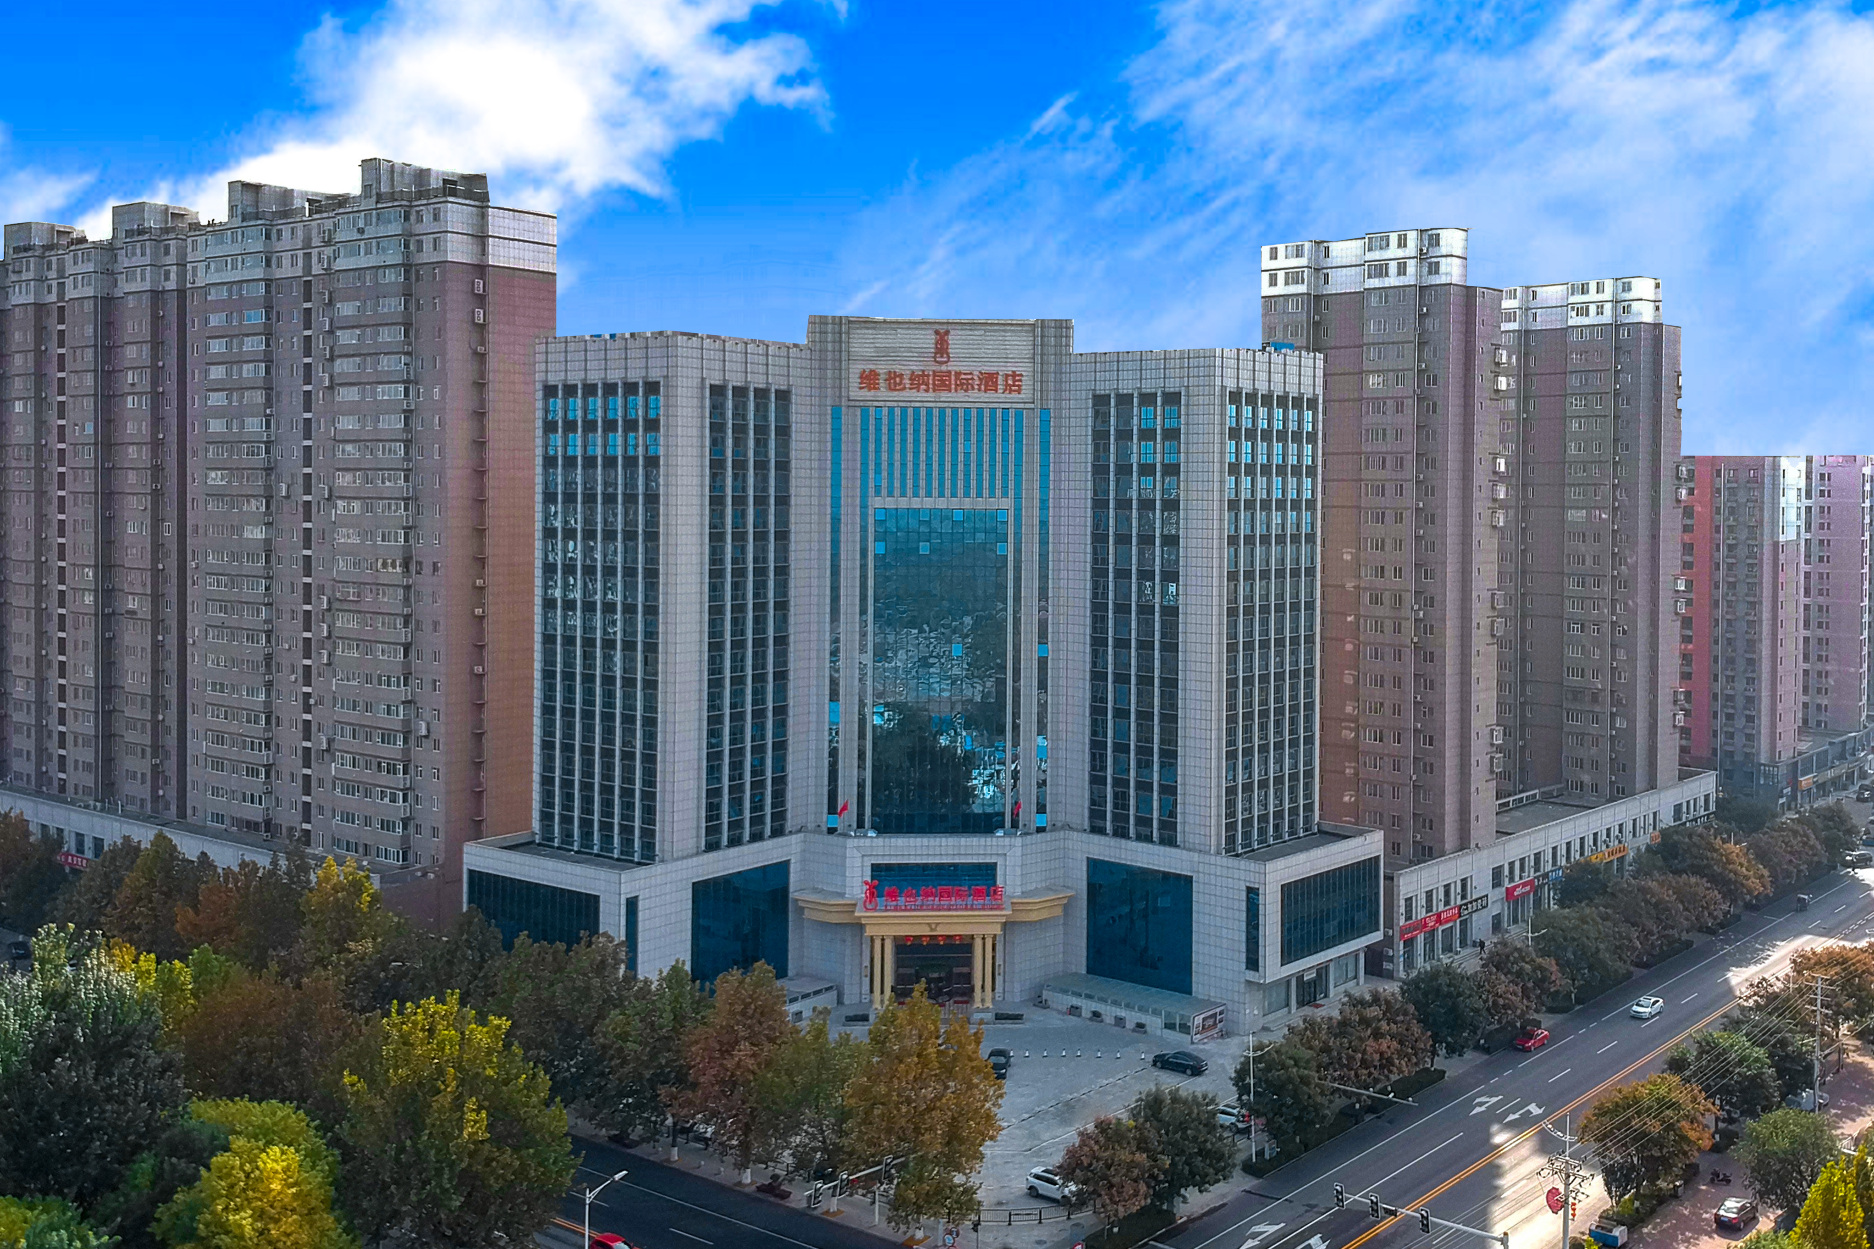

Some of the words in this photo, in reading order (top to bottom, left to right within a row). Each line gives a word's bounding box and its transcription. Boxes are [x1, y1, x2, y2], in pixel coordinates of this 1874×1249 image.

[859, 369, 1023, 394] 维也纳国际酒店
[884, 885, 1005, 904] 维也纳国际酒店
